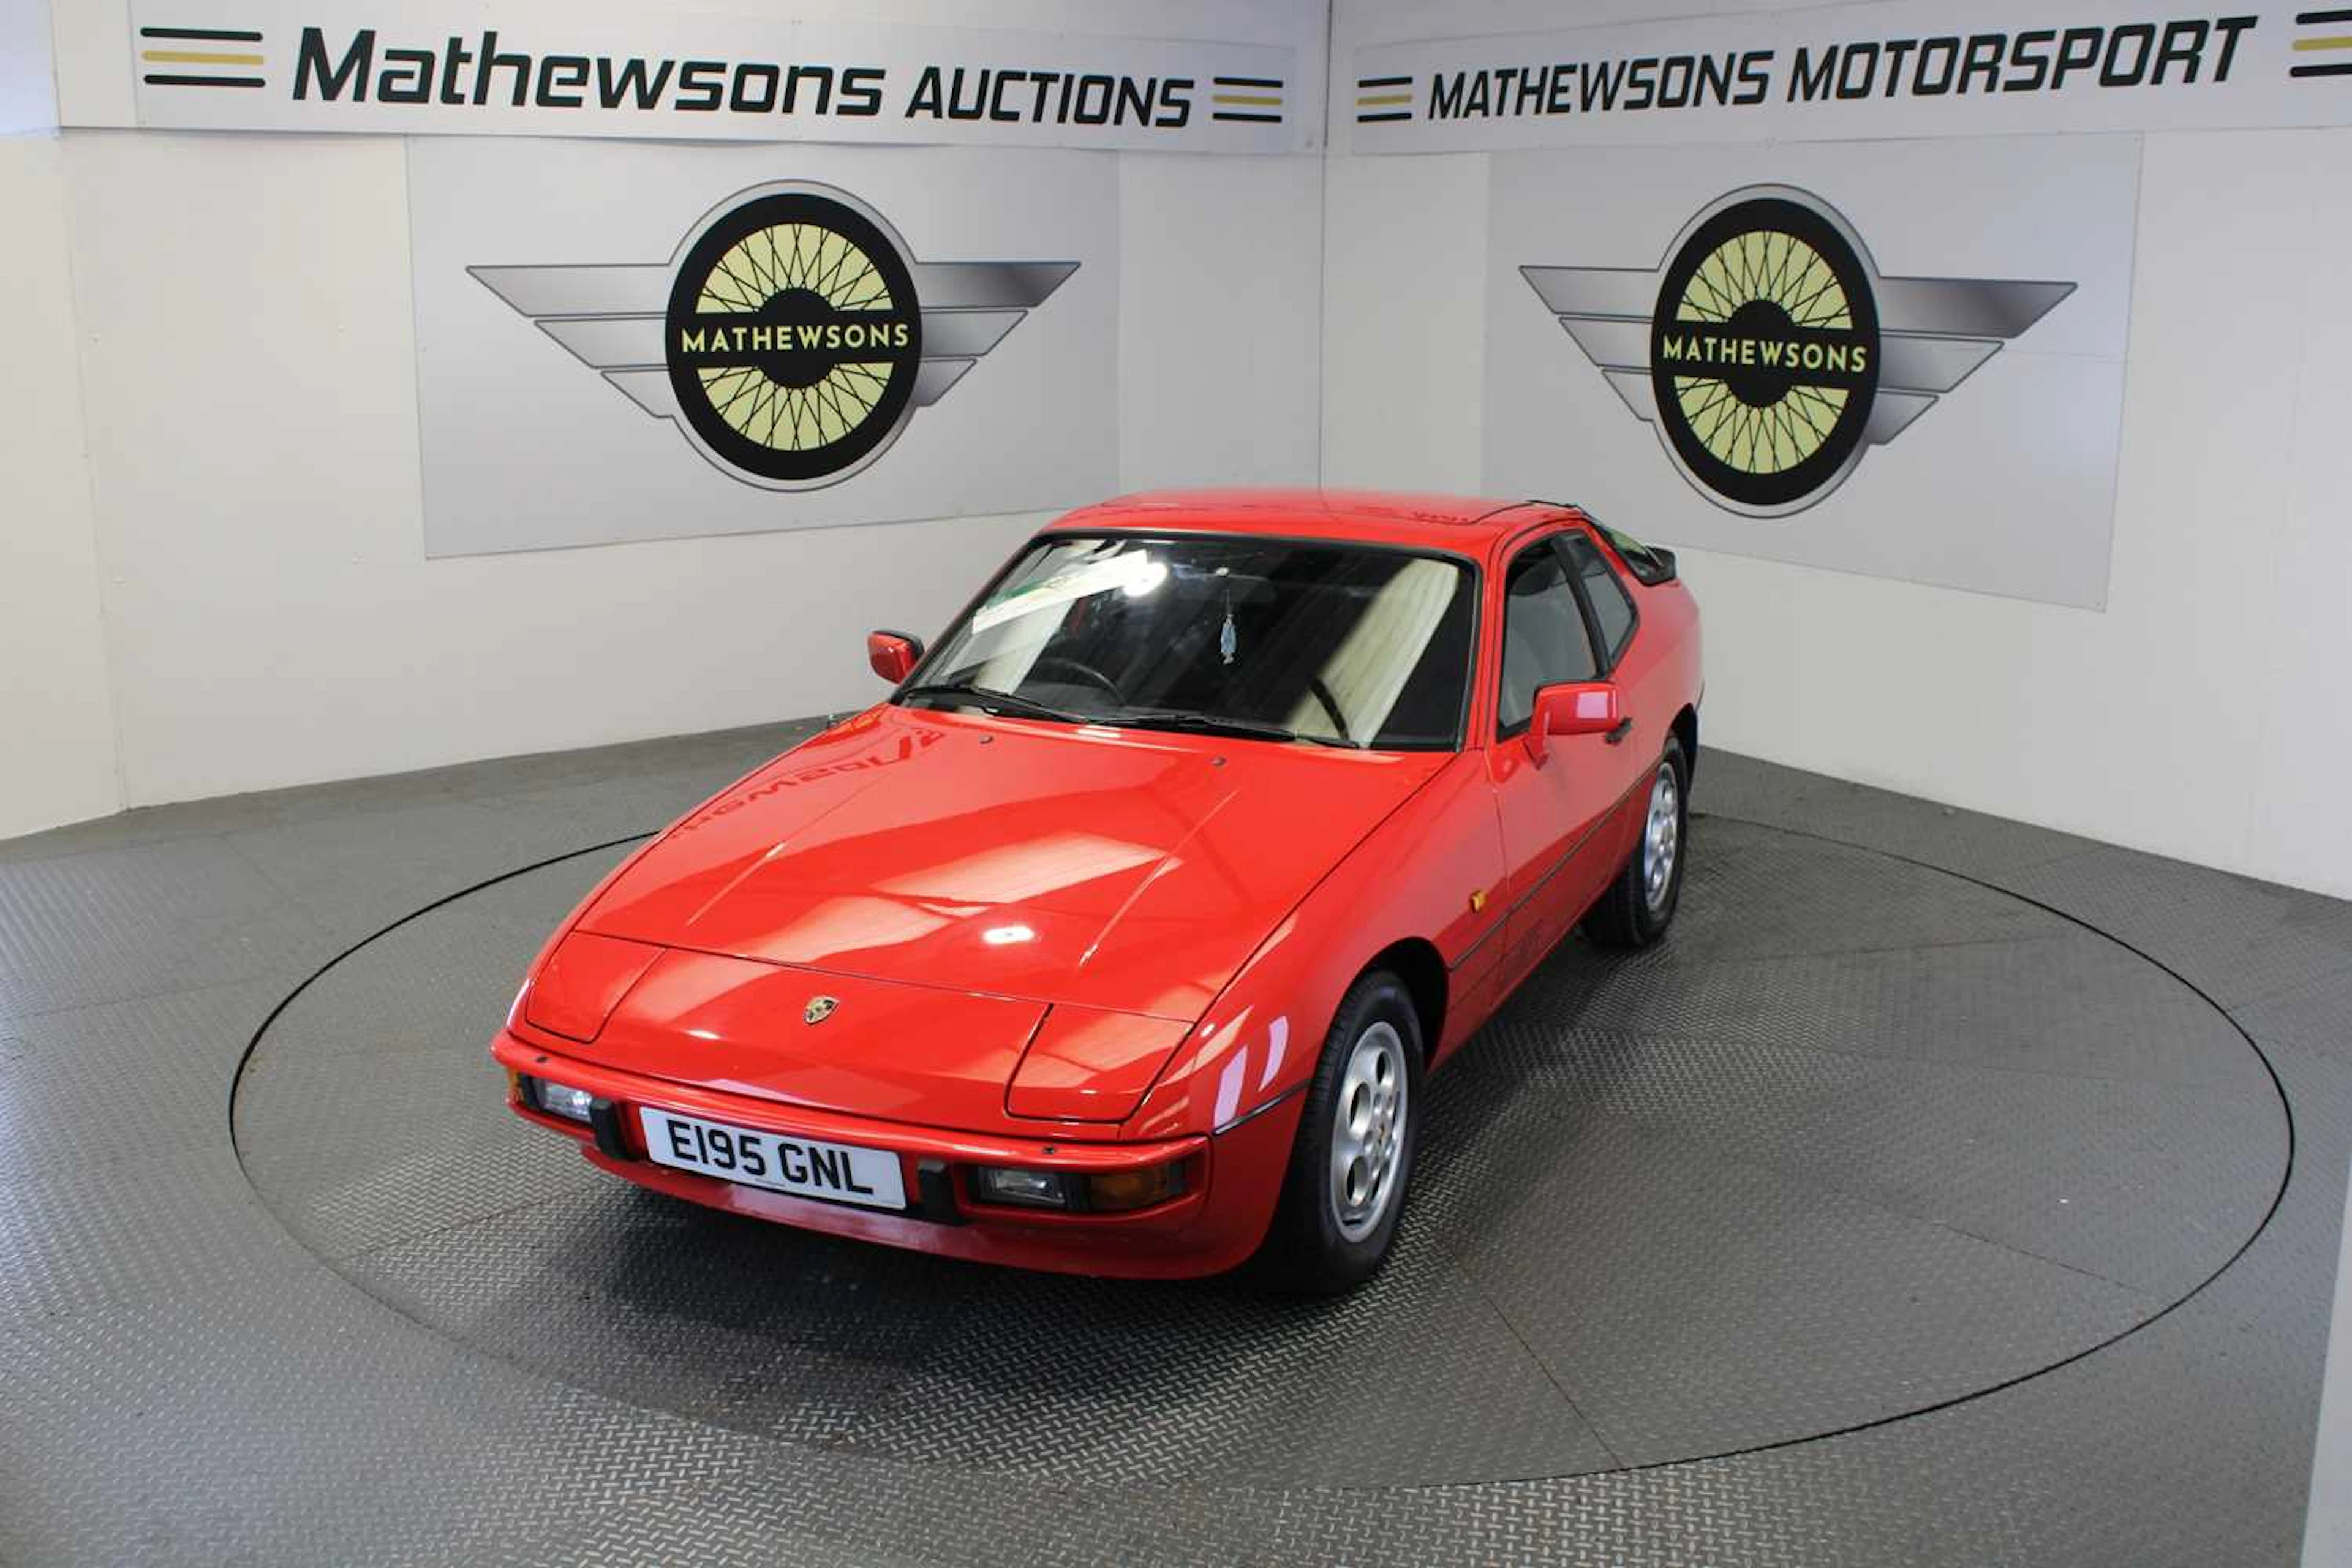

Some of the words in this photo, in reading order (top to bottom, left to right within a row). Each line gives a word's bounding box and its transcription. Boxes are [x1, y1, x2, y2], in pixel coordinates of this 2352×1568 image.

[293, 28, 886, 116] Mathewsons
[905, 67, 1194, 127] AUCTIONS
[1429, 51, 1774, 119] MATHEWSONS
[1787, 16, 2258, 102] MOTORSPORT
[682, 323, 909, 353] MATHEWSONS
[1662, 336, 1867, 372] MATHEWSONS
[667, 1120, 766, 1176] E195
[778, 1143, 874, 1194] GNL
